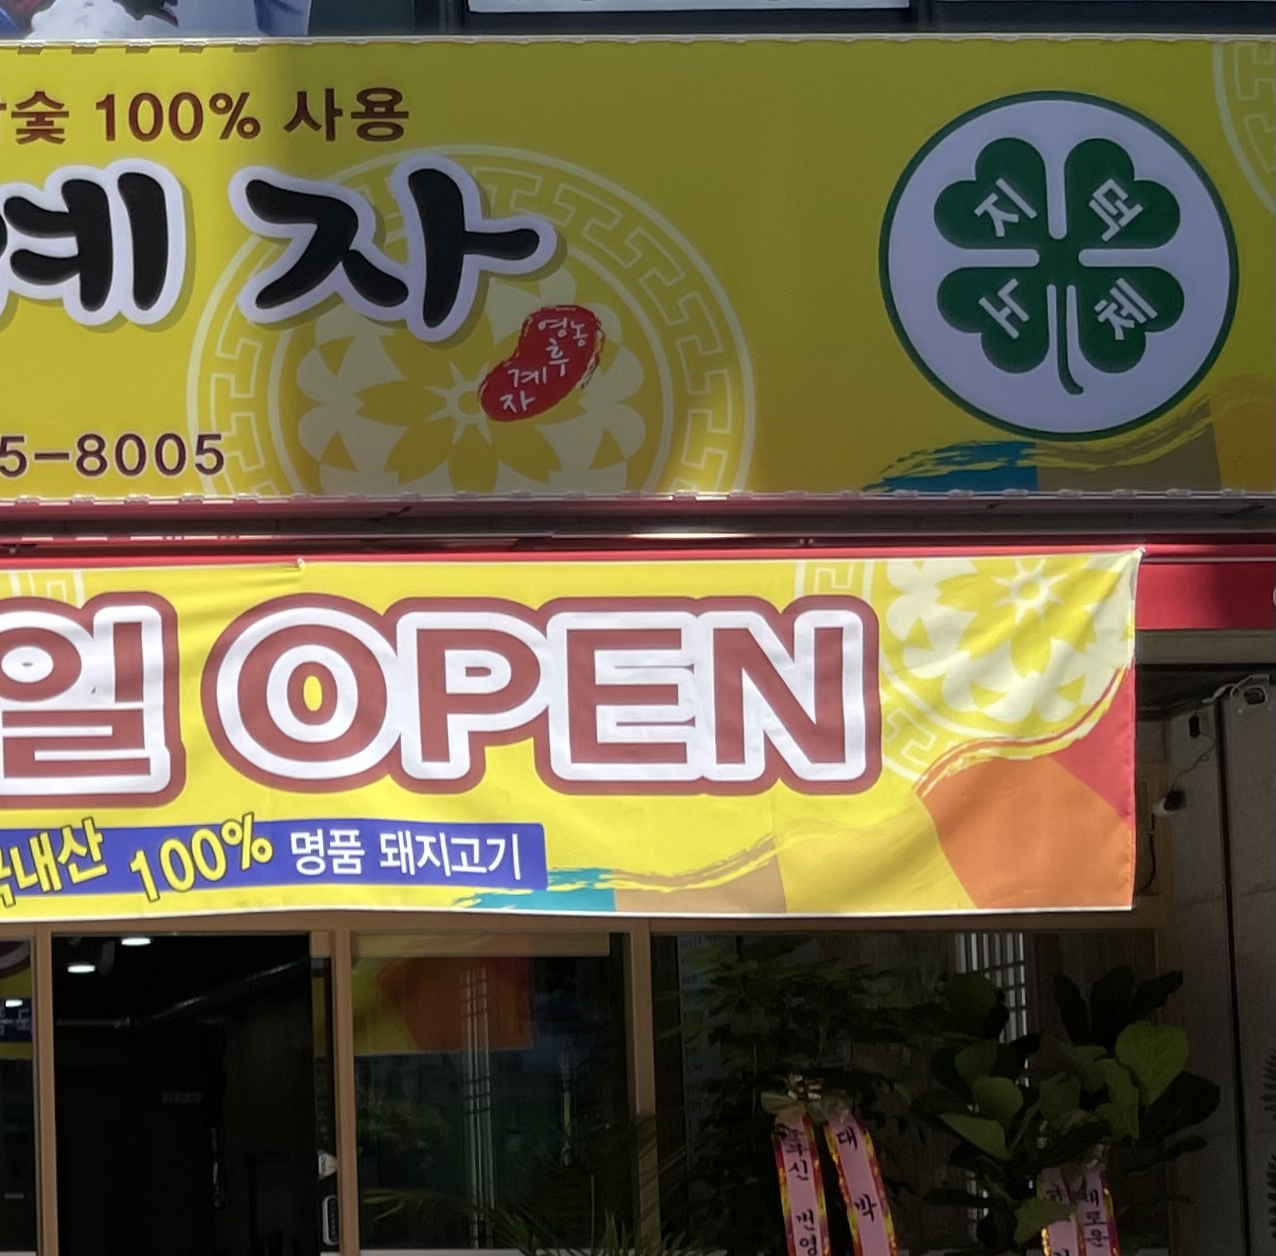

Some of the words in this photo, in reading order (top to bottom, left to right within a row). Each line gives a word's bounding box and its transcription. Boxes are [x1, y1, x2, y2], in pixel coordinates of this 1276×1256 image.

[94, 90, 262, 143] 100%
[283, 86, 411, 142] 사용
[974, 177, 1038, 237] 지
[1088, 178, 1144, 242] 덕
[977, 277, 1031, 340] 노
[1093, 276, 1158, 341] 체
[212, 606, 871, 784] OPEN
[127, 810, 275, 904] 100%
[290, 831, 367, 877] 명품
[379, 830, 521, 882] 돼지고기
